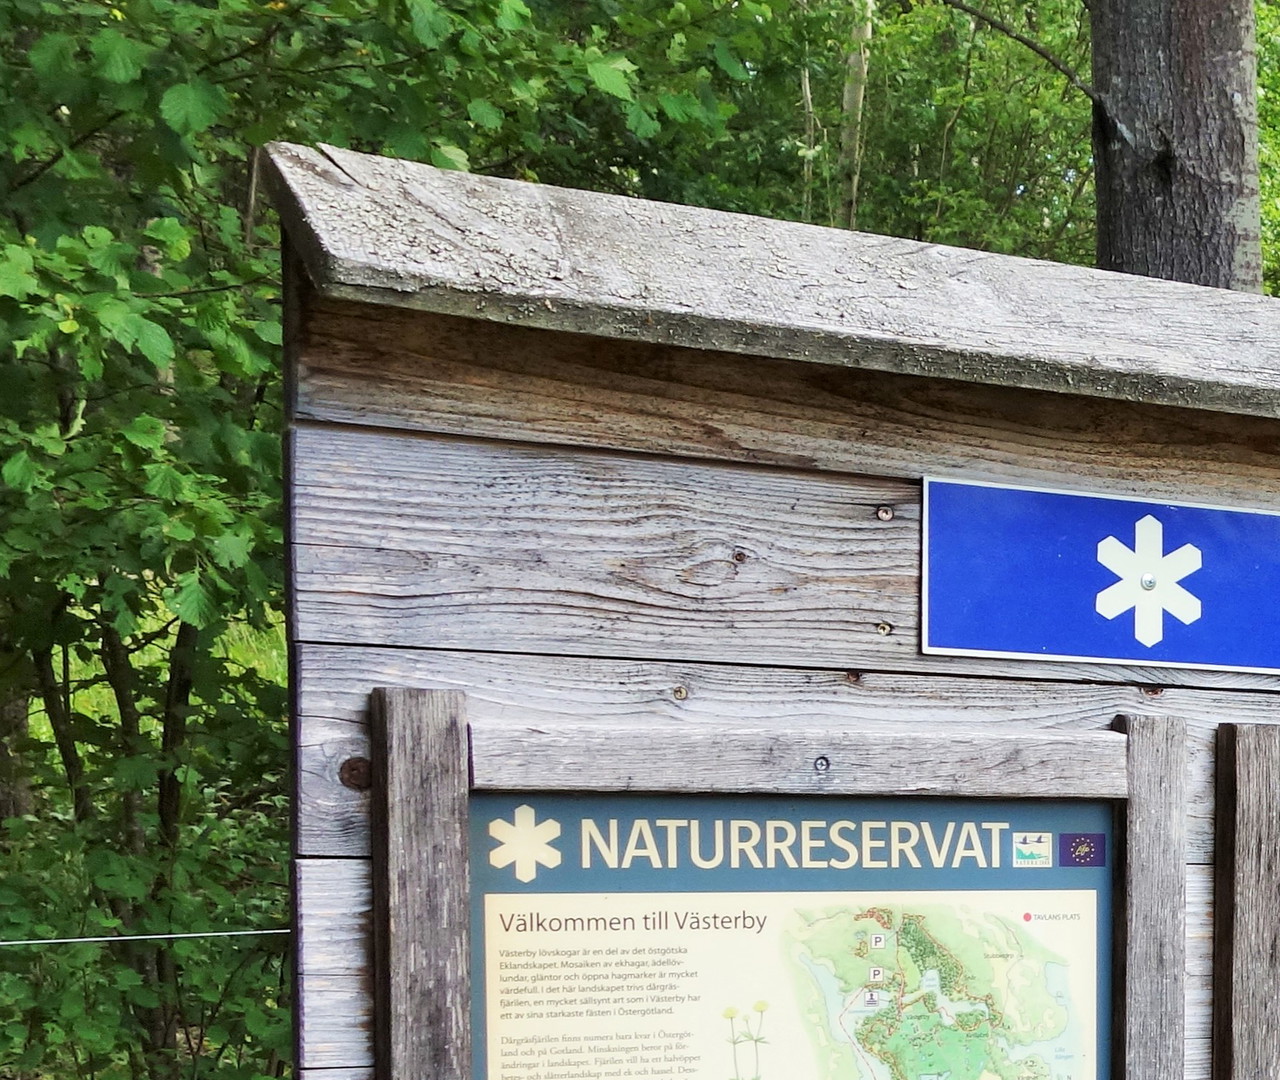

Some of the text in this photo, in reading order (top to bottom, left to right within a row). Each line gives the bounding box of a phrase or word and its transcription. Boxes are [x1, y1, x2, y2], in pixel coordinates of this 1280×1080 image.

[581, 819, 1009, 869] NATURRESERVAT
[500, 910, 767, 934] Välkommen till Västerby
[499, 949, 537, 960] Västerby
[538, 948, 580, 959] lövskogar
[582, 948, 590, 956] är
[605, 947, 618, 956] del
[632, 947, 645, 955] det
[648, 946, 687, 957] östgötska
[499, 960, 558, 972] Eklandskapet.
[560, 960, 600, 969] Mosaiken
[614, 958, 649, 970] ekhagar,
[651, 958, 683, 967] ädellöv-
[499, 970, 697, 984] lundar, gläntor och öppna hagmarker är mycket
[499, 982, 679, 995] värdefull. I det här landskapet trivs dårgräs-
[499, 998, 531, 1010] fjärilen,
[546, 997, 577, 1008] mycket
[579, 996, 610, 1007] sällsynt
[612, 996, 624, 1004] art
[645, 994, 648, 1003] i
[649, 993, 685, 1005] Västerby
[687, 993, 700, 1002] har
[526, 1010, 543, 1019] sina
[545, 1009, 583, 1018] starkaste
[585, 1008, 611, 1017] fästen
[613, 1008, 615, 1016] i
[617, 1005, 673, 1019] Östergötland.
